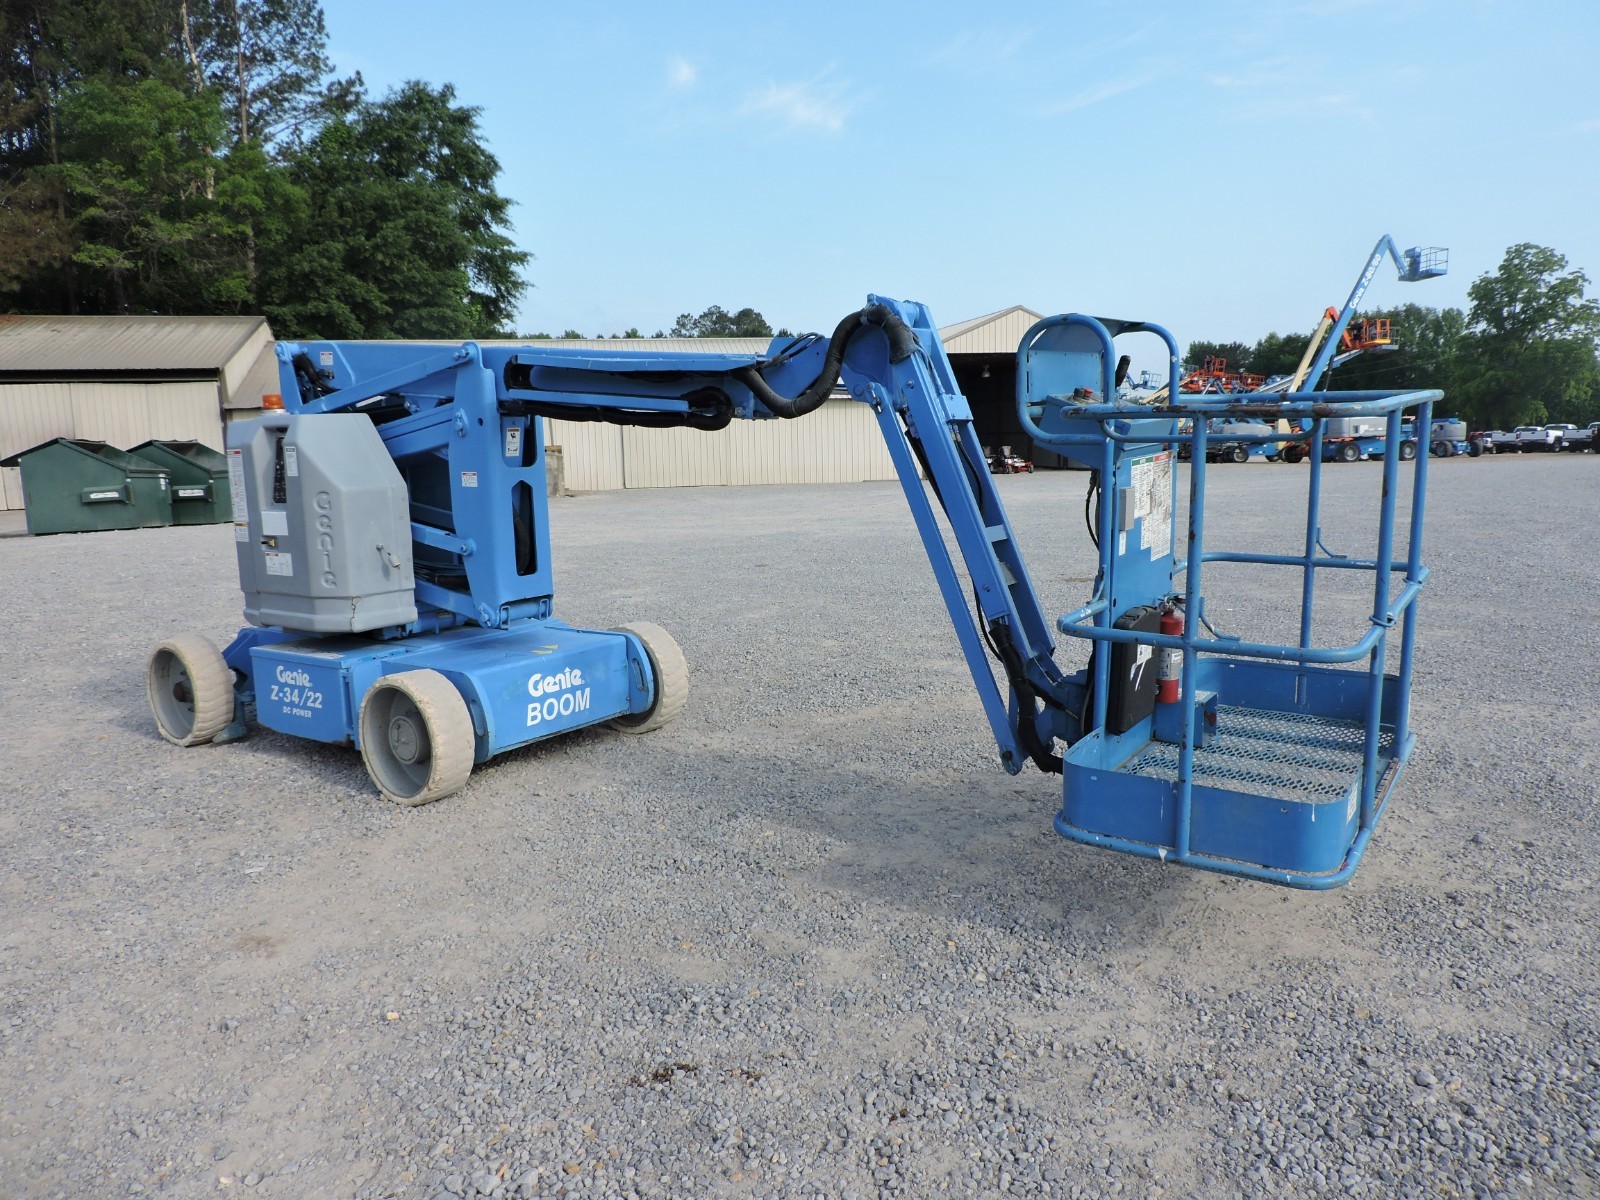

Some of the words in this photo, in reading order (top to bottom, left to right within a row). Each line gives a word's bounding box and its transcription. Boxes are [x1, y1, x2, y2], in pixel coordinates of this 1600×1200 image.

[276, 665, 313, 687] Genie
[527, 666, 586, 698] Genie
[270, 685, 323, 709] Z-34/22
[526, 687, 591, 727] BOOM
[282, 705, 292, 714] DC
[292, 707, 312, 718] POWER
